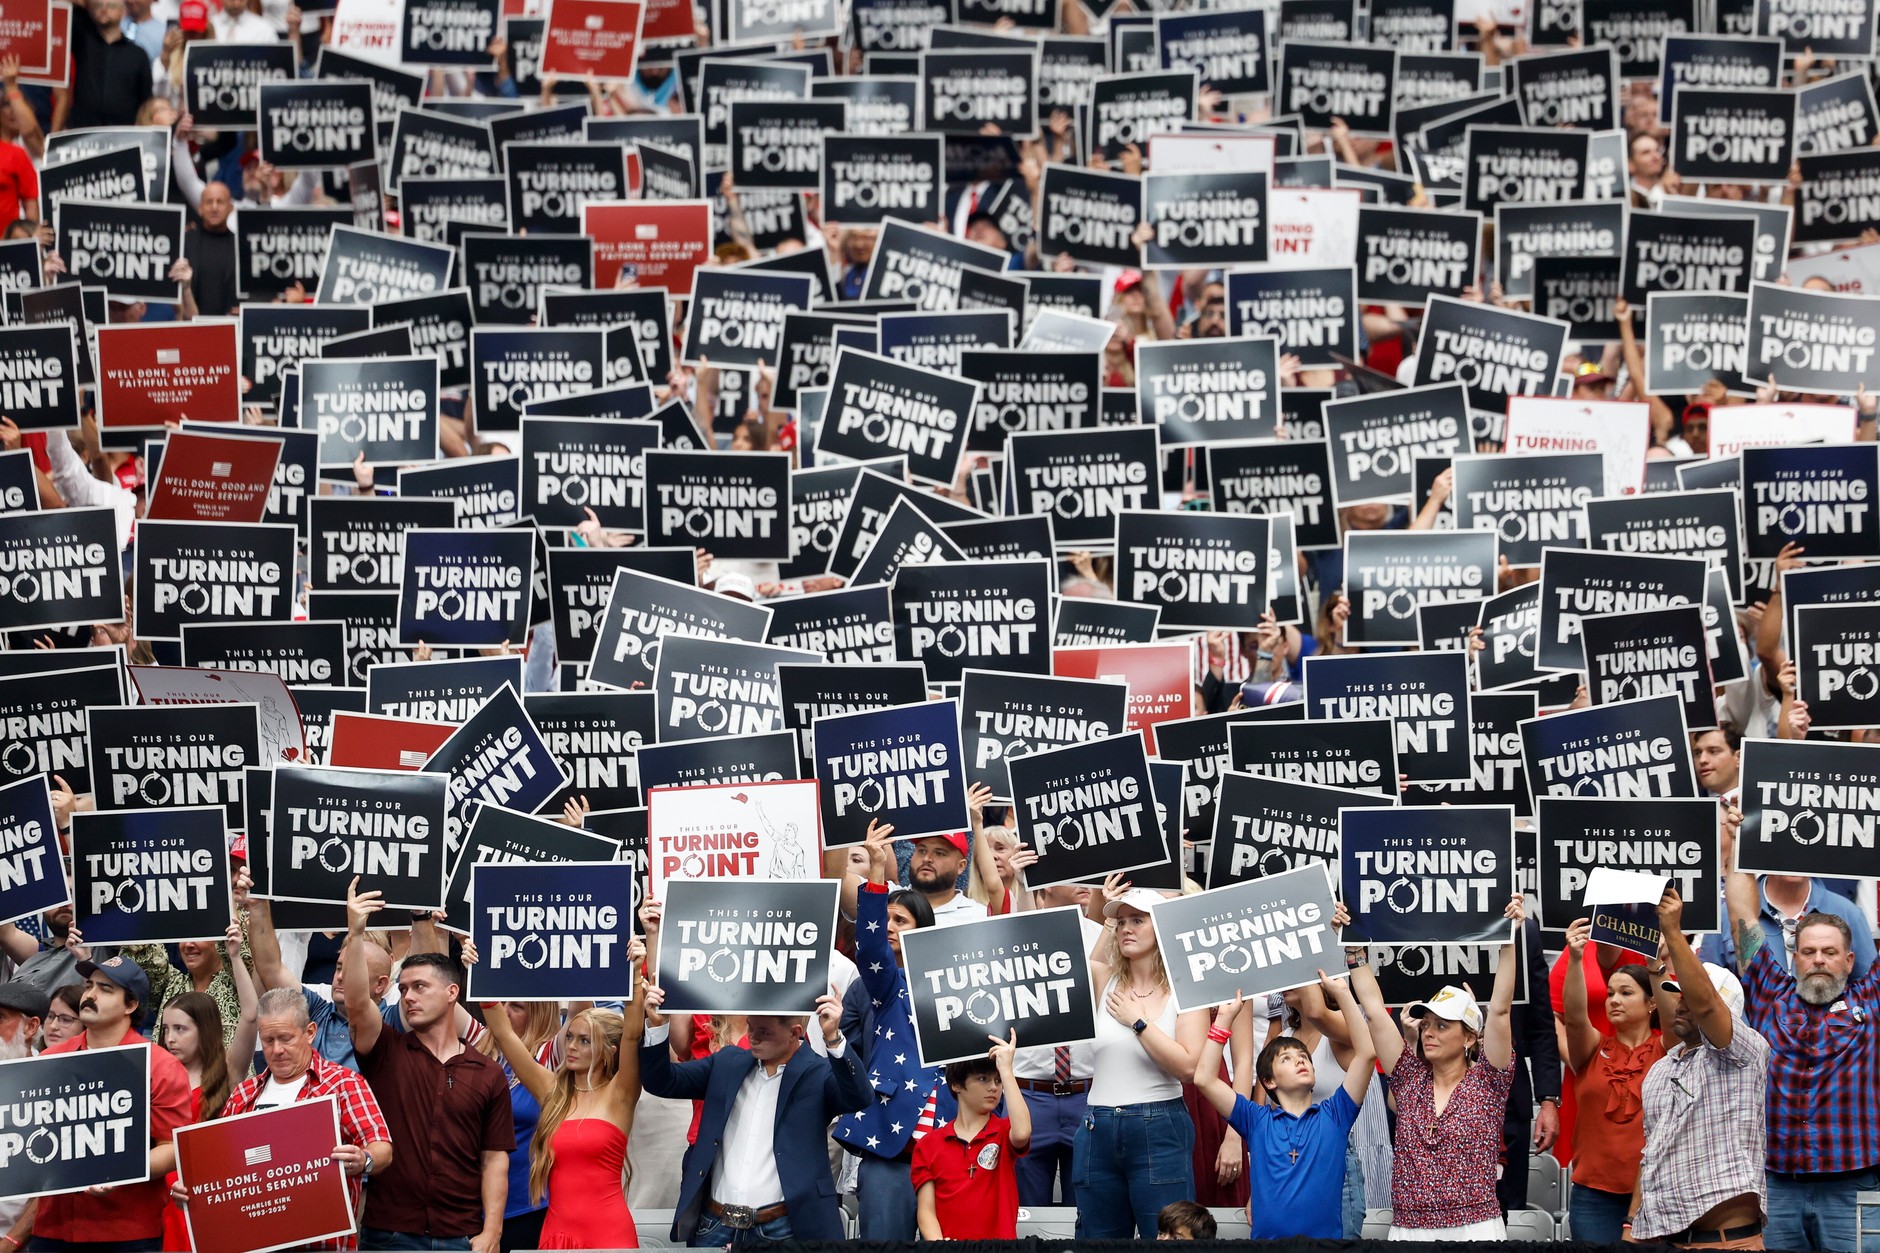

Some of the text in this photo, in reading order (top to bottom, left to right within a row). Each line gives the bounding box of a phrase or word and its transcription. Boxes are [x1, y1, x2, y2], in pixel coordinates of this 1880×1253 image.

[268, 108, 363, 125] TURNING
[1685, 117, 1784, 136] TURNING
[273, 126, 364, 150] POINT
[1687, 135, 1784, 162] POINT
[1154, 199, 1257, 219] TURNING
[68, 231, 170, 253] TURNING
[1159, 219, 1258, 246] POINT
[71, 250, 169, 280] POINT
[1760, 317, 1874, 346] TURNING
[1434, 331, 1548, 369] TURNING
[1761, 338, 1873, 375] POINT
[108, 370, 133, 379] WELL
[209, 365, 230, 374] AND
[1150, 370, 1265, 393] TURNING
[1431, 353, 1544, 397] POINT
[312, 390, 425, 413] TURNING
[844, 383, 956, 429] TURNING
[1155, 392, 1266, 422] POINT
[317, 413, 425, 442] POINT
[838, 406, 952, 459] POINT
[657, 486, 776, 507] TURNING
[1753, 479, 1867, 502] TURNING
[662, 507, 777, 538] POINT
[1758, 503, 1868, 534] POINT
[150, 559, 280, 583] TURNING
[1130, 547, 1255, 571] TURNING
[415, 566, 522, 587] TURNING
[1134, 570, 1255, 604] POINT
[154, 582, 279, 616] POINT
[415, 588, 521, 621] POINT
[905, 598, 1035, 623] TURNING
[911, 624, 1036, 656] POINT
[850, 733, 920, 750] THIS IS OUR
[105, 744, 244, 769] TURNING
[827, 742, 947, 779] TURNING
[113, 770, 243, 803] POINT
[1045, 778, 1069, 789] THIS
[1091, 769, 1111, 779] OUR
[1788, 771, 1820, 779] THIS
[1850, 775, 1877, 783] OUR
[318, 798, 347, 806] THIS
[376, 801, 400, 809] OUR
[834, 769, 949, 815] POINT
[1024, 776, 1138, 819] TURNING
[1757, 782, 1880, 810] TURNIN
[288, 808, 429, 839] TURNING
[1033, 802, 1143, 856] POINT
[1760, 808, 1880, 848] POIN
[111, 841, 136, 849] THIS
[162, 838, 184, 846] OUR
[658, 831, 759, 852] TURNING
[1421, 838, 1432, 846] IS
[1441, 837, 1466, 845] OUR
[1554, 840, 1701, 865] TURNING
[86, 848, 212, 877] TURNING
[291, 836, 428, 878] POINT
[663, 851, 760, 878] POINT
[1354, 849, 1496, 874] TURNING
[91, 877, 213, 913] POINT
[515, 894, 542, 902] THIS
[1360, 876, 1496, 913] POINT
[487, 906, 617, 930] TURNING
[709, 909, 738, 917] THIS
[1202, 899, 1286, 924] THIS IS OUR
[677, 921, 817, 945] TURNING
[1175, 903, 1320, 952] TURNING
[1596, 914, 1660, 943] CHARLIE
[491, 932, 617, 969] POINT
[678, 946, 816, 982] POINT
[952, 942, 1038, 961] THIS IS OUR
[1187, 924, 1326, 982] POINT
[923, 951, 1071, 993] TURNING
[935, 978, 1075, 1030] POINT
[20, 1081, 103, 1098] THIS IS OUR
[0, 1117, 132, 1168] POINT
[192, 1158, 330, 1195] WELL DONE, GOOD AND
[207, 1172, 319, 1205] FAITHFUL SERVANT
[241, 1196, 291, 1212] CHARLIE KIRK
